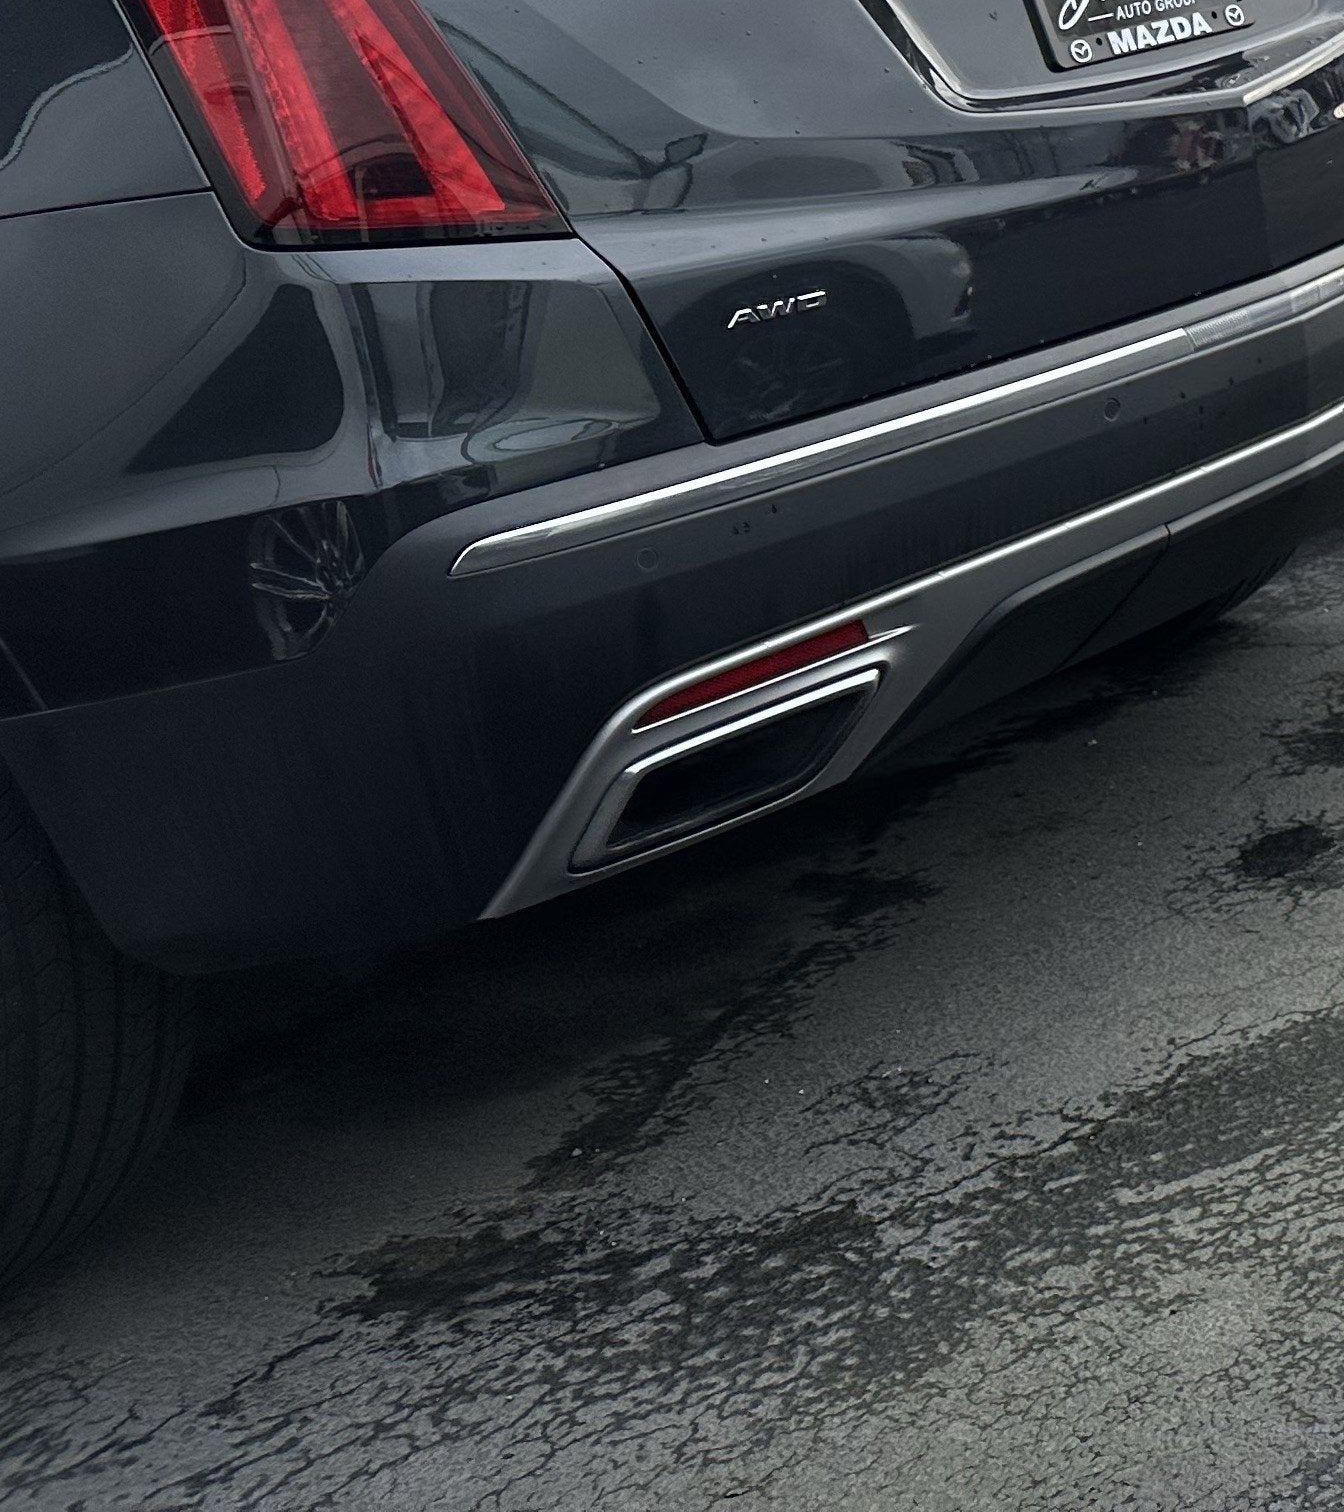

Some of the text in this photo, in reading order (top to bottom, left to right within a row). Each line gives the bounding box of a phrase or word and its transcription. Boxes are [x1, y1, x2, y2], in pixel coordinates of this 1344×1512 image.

[1115, 1, 1152, 21] AUTO
[1107, 11, 1213, 55] MAZDA
[727, 290, 827, 330] AWD
